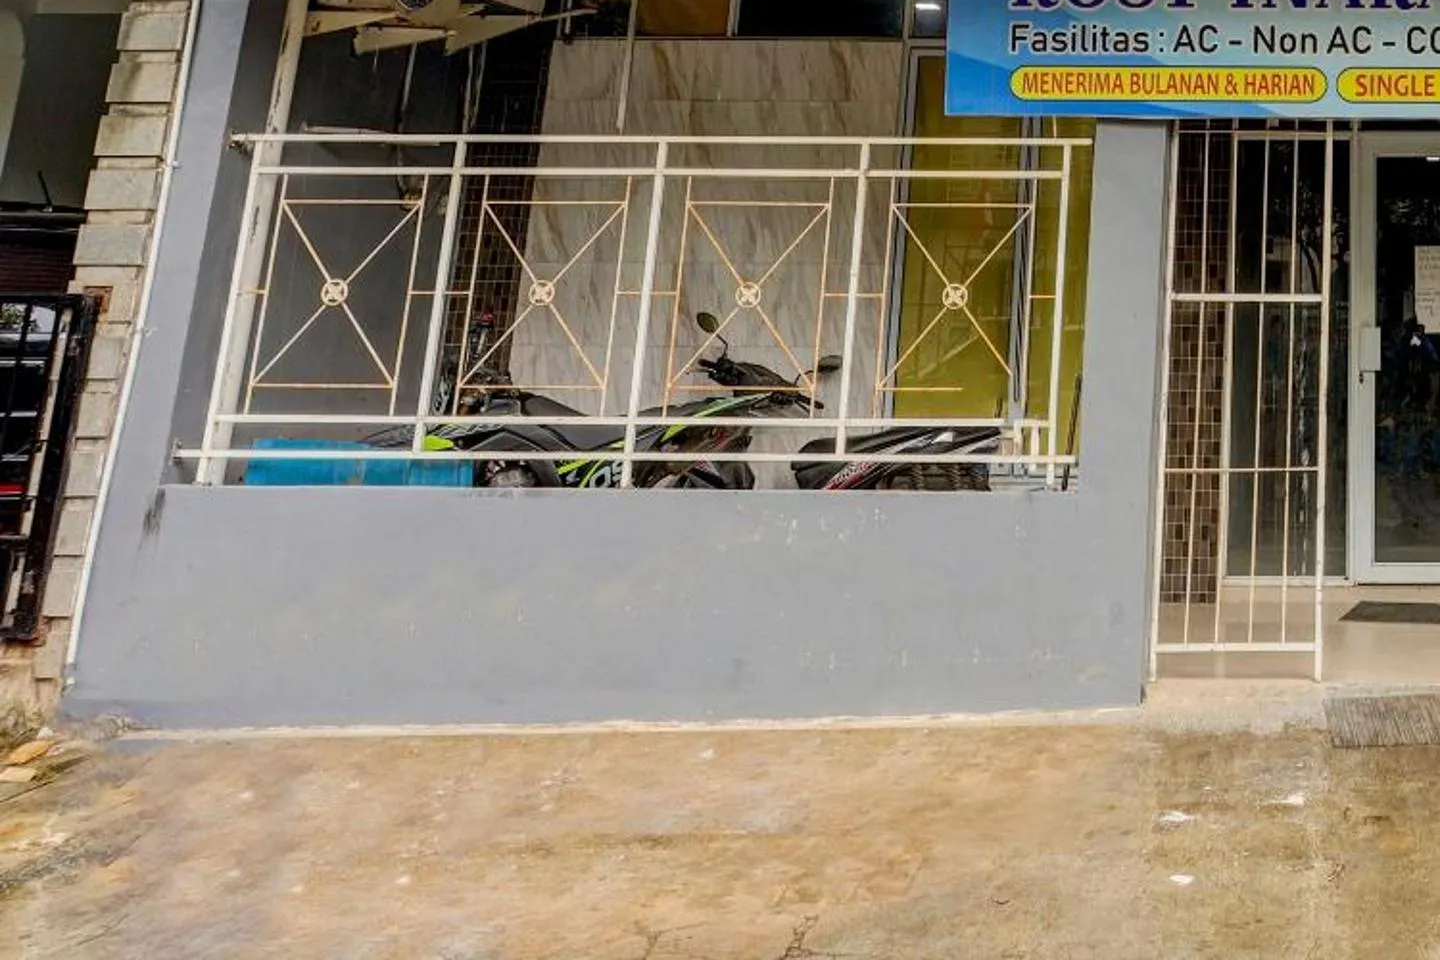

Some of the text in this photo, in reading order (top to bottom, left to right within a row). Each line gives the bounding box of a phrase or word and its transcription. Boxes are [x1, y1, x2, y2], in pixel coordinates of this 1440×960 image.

[1010, 24, 1151, 53] Fasilitas
[1173, 25, 1219, 53] AC
[1254, 26, 1317, 54] Non
[1327, 27, 1372, 54] AC
[1023, 72, 1315, 96] MENERIMA BULANAN & HARIAN
[1355, 74, 1436, 97] SINGLE
